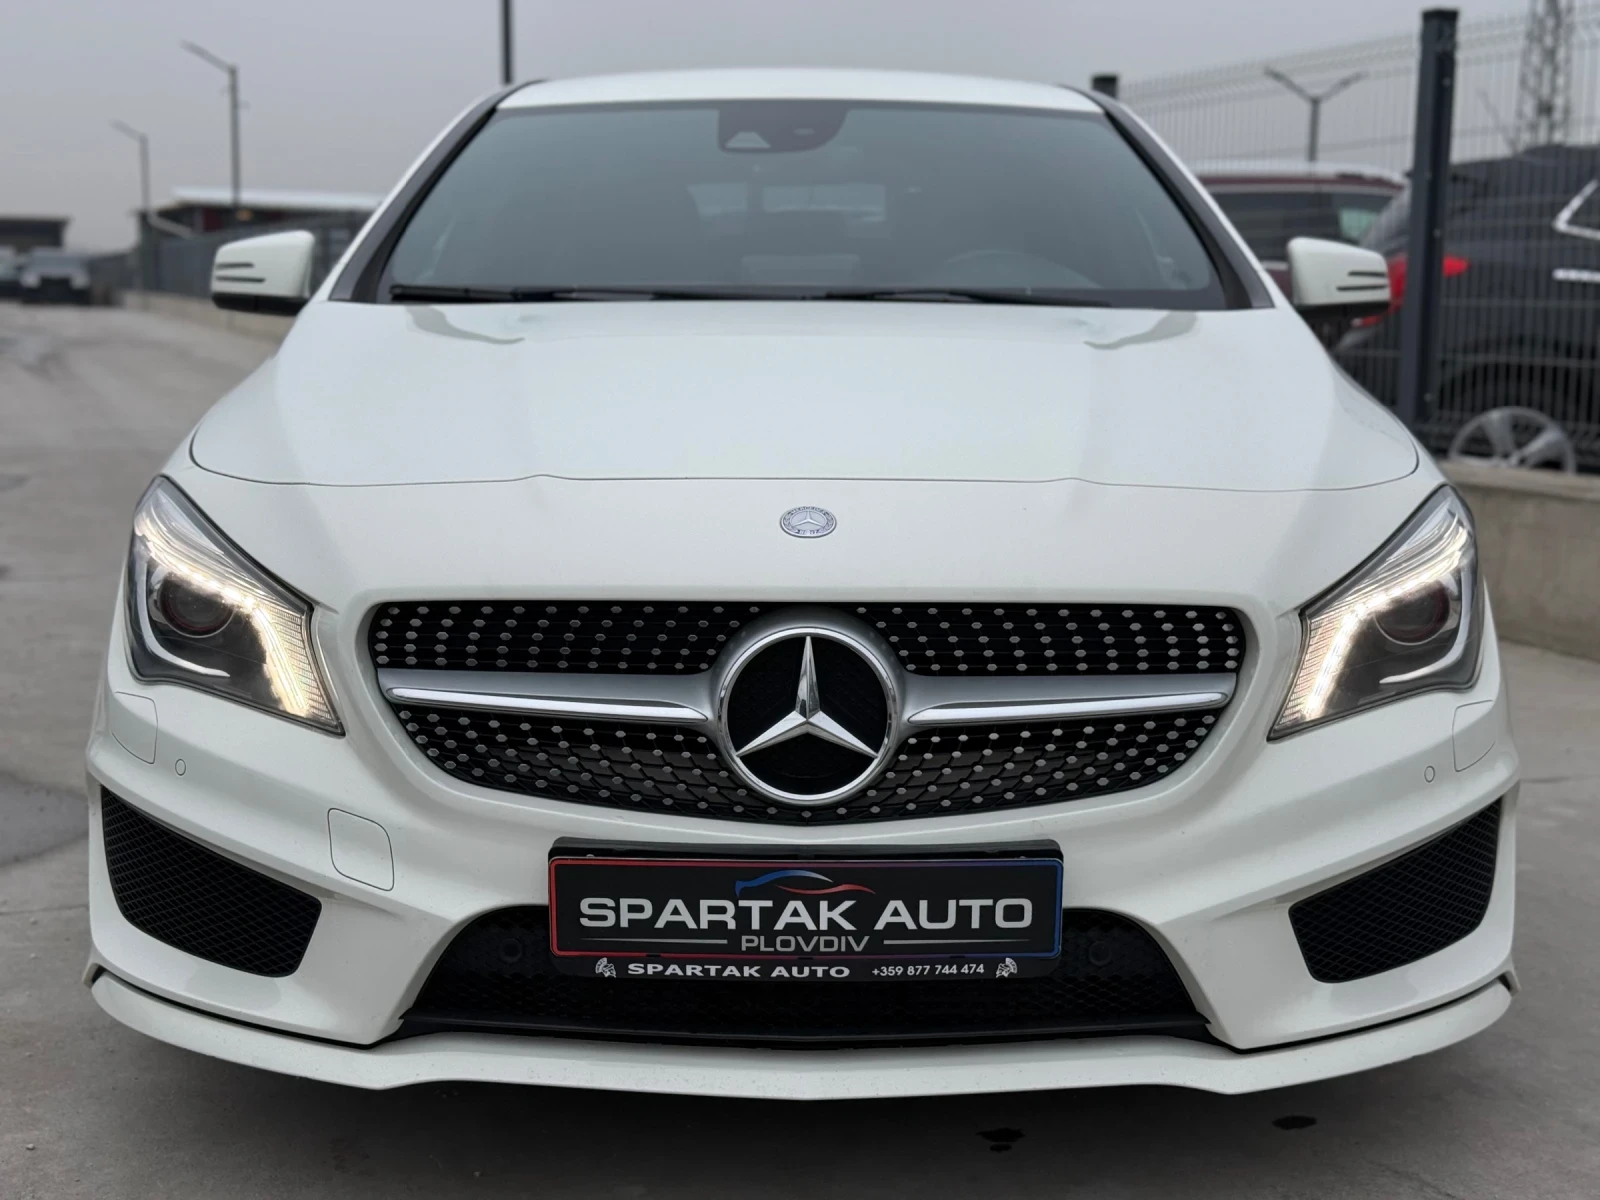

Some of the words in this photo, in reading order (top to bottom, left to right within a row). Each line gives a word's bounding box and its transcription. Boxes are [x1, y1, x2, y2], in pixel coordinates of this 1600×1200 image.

[579, 897, 857, 931] SPARTAK
[873, 898, 1033, 930] AUTO
[741, 935, 870, 952] PLOVDIV
[627, 963, 761, 978] SPARTAK
[770, 966, 850, 978] AUTO
[872, 966, 904, 976] +359
[907, 965, 930, 976] 877
[935, 964, 957, 975] 744
[960, 963, 984, 974] 474
